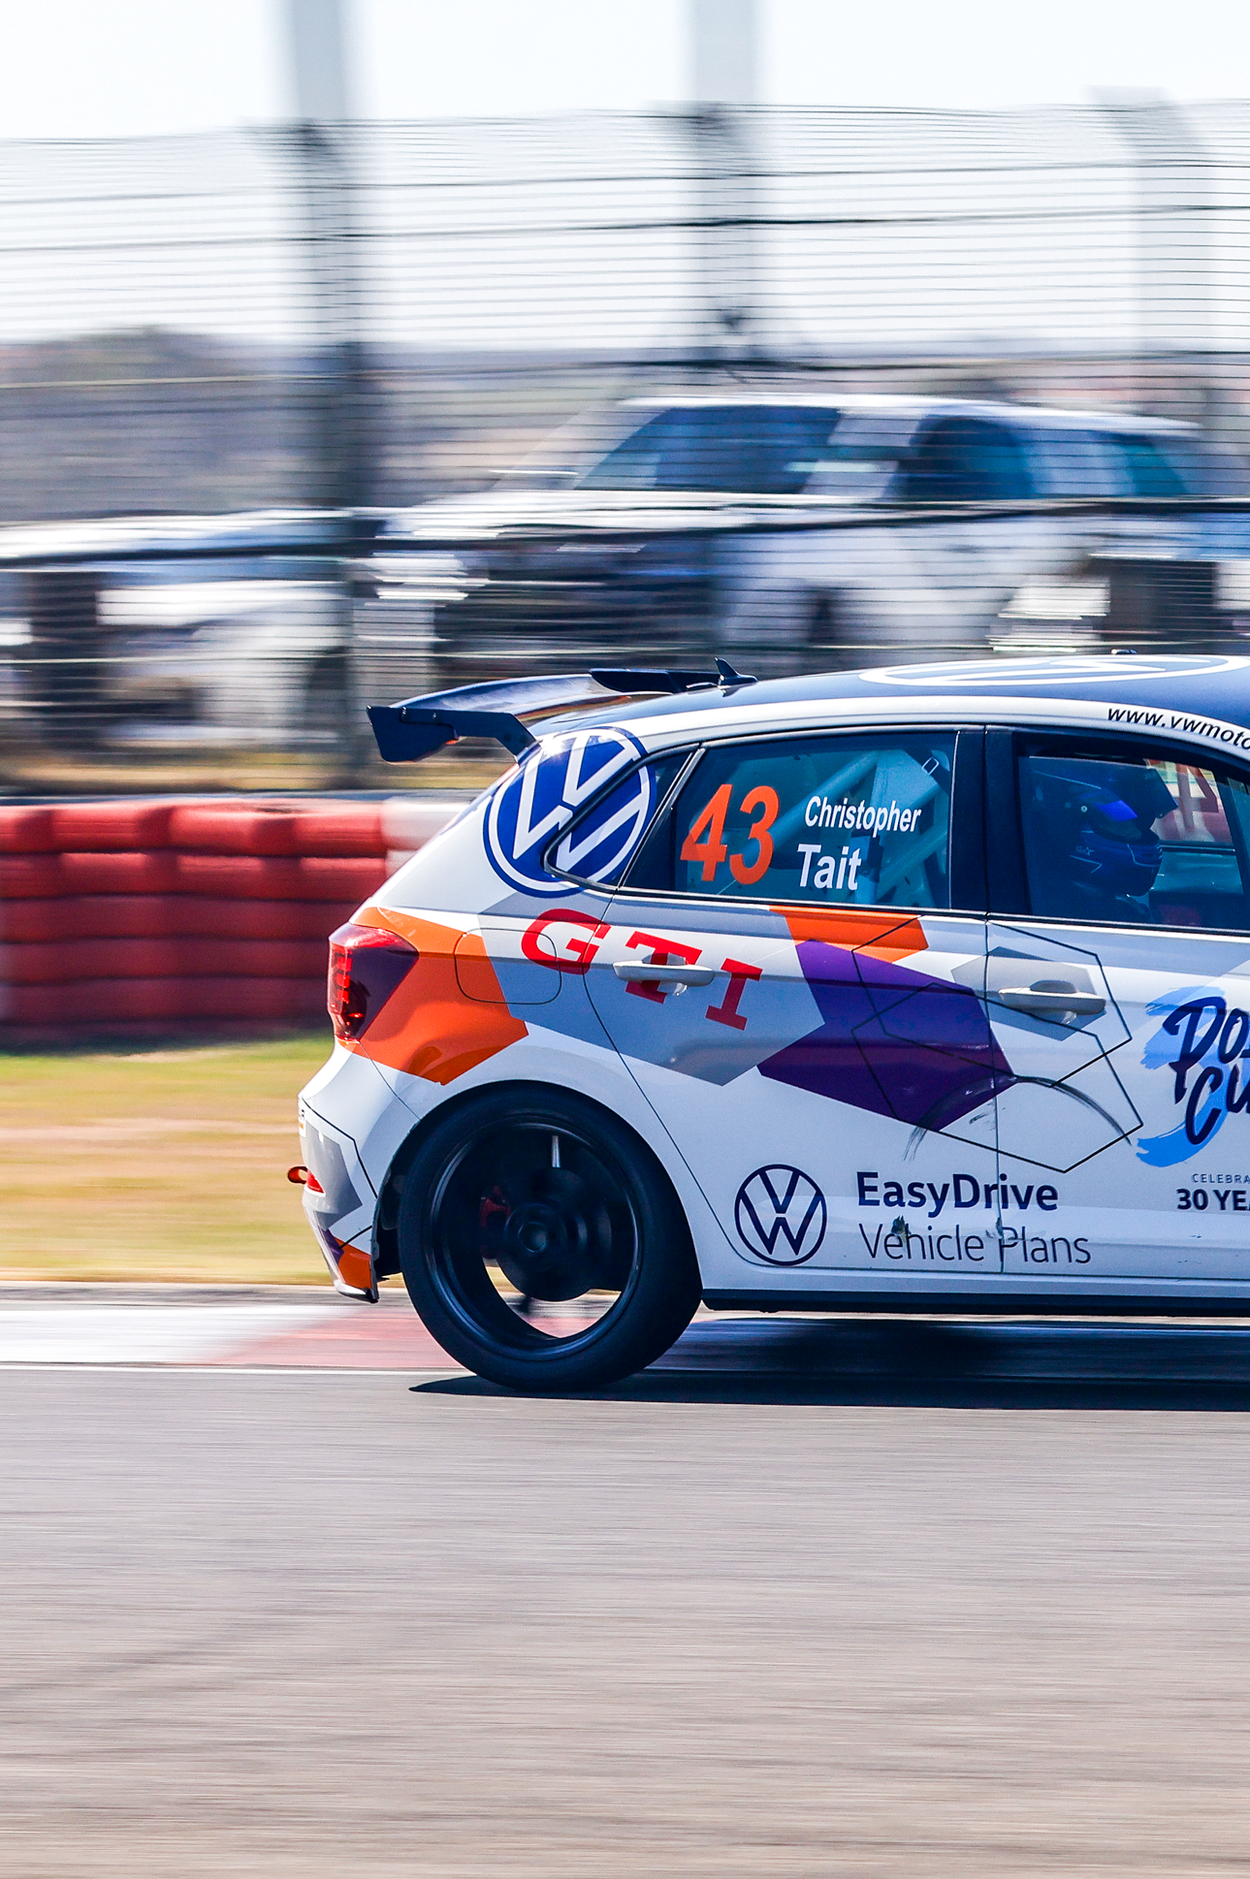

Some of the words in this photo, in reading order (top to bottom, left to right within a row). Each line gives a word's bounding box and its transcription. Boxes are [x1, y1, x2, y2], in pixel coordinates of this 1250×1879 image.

[680, 784, 780, 885] 43
[804, 795, 922, 838] Christopher
[797, 843, 862, 890] Tait
[521, 908, 763, 1030] GTI
[856, 1171, 1059, 1218] EasyDrive
[1176, 1189, 1209, 1211] 30
[858, 1223, 984, 1262] Vehicle
[1000, 1225, 1092, 1264] Plans
